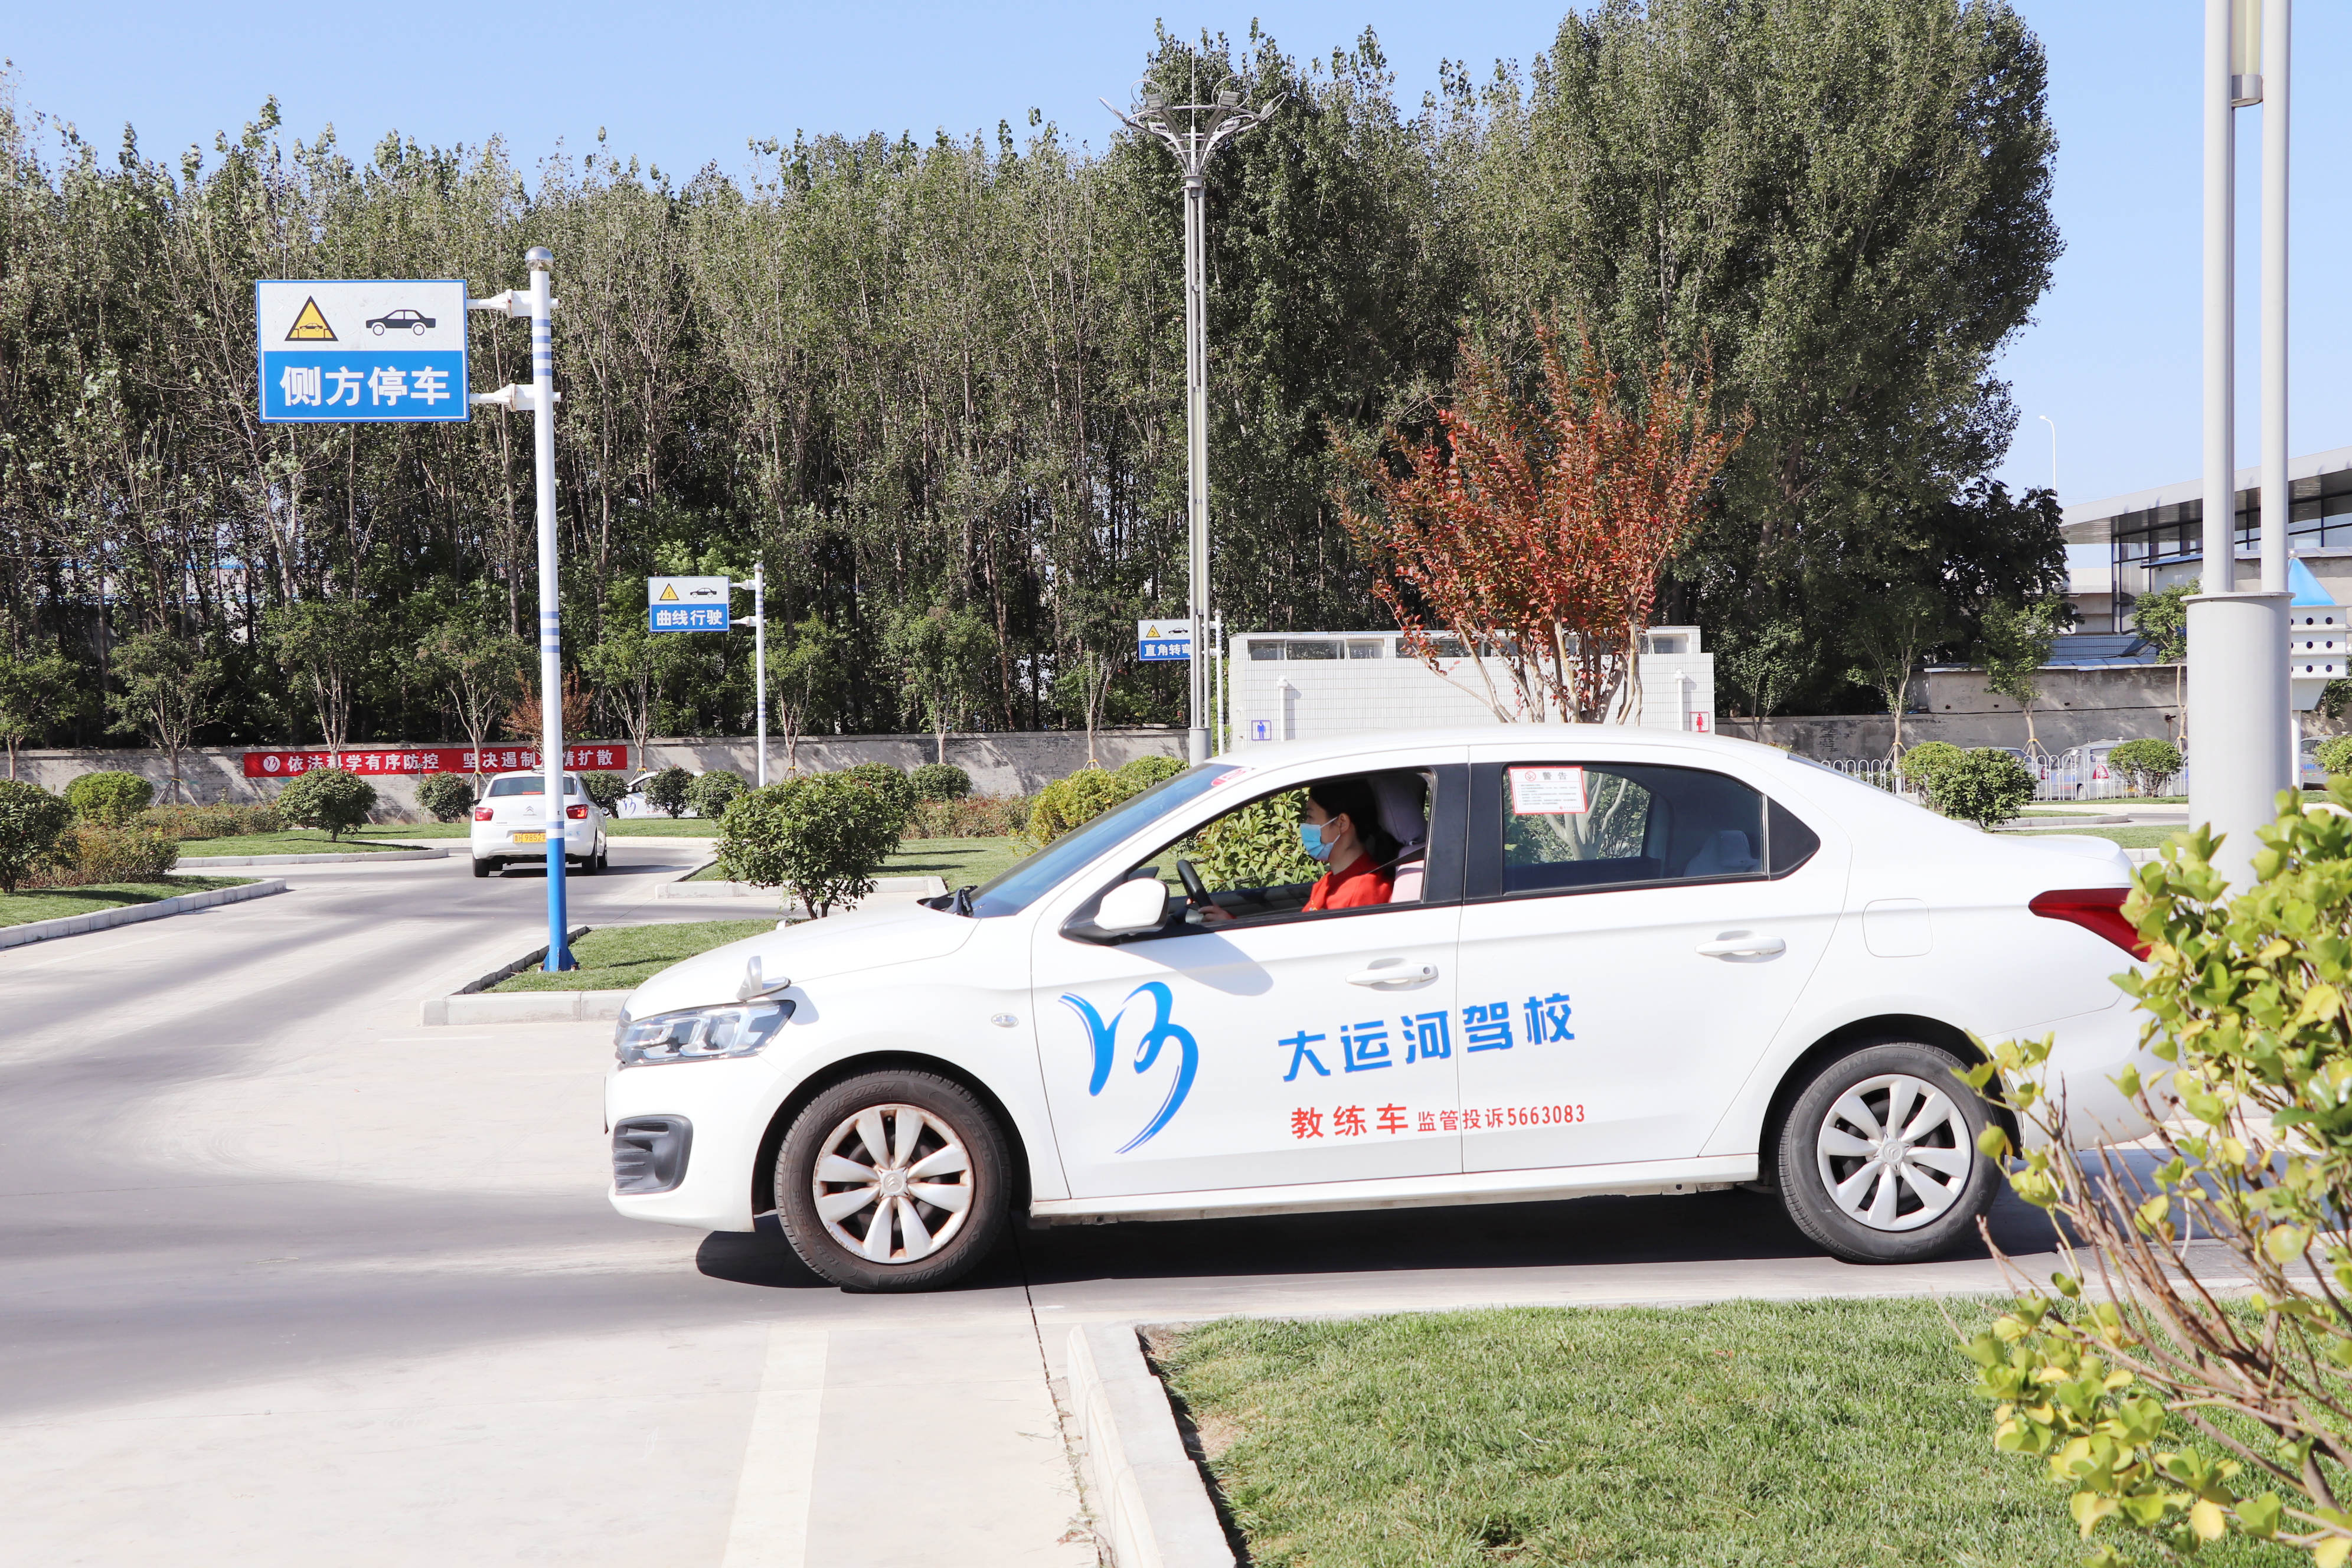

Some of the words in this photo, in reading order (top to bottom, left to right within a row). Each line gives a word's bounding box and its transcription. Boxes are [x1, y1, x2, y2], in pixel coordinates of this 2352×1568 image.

[279, 366, 450, 406] 侧方停车
[656, 609, 723, 626] 曲线行驶
[463, 749, 613, 769] 坚决遏制情扩散
[1278, 992, 1576, 1082] 大运河驾校
[1291, 1103, 1409, 1140] 教练车
[1417, 1104, 1585, 1133] 监管投诉5663083
